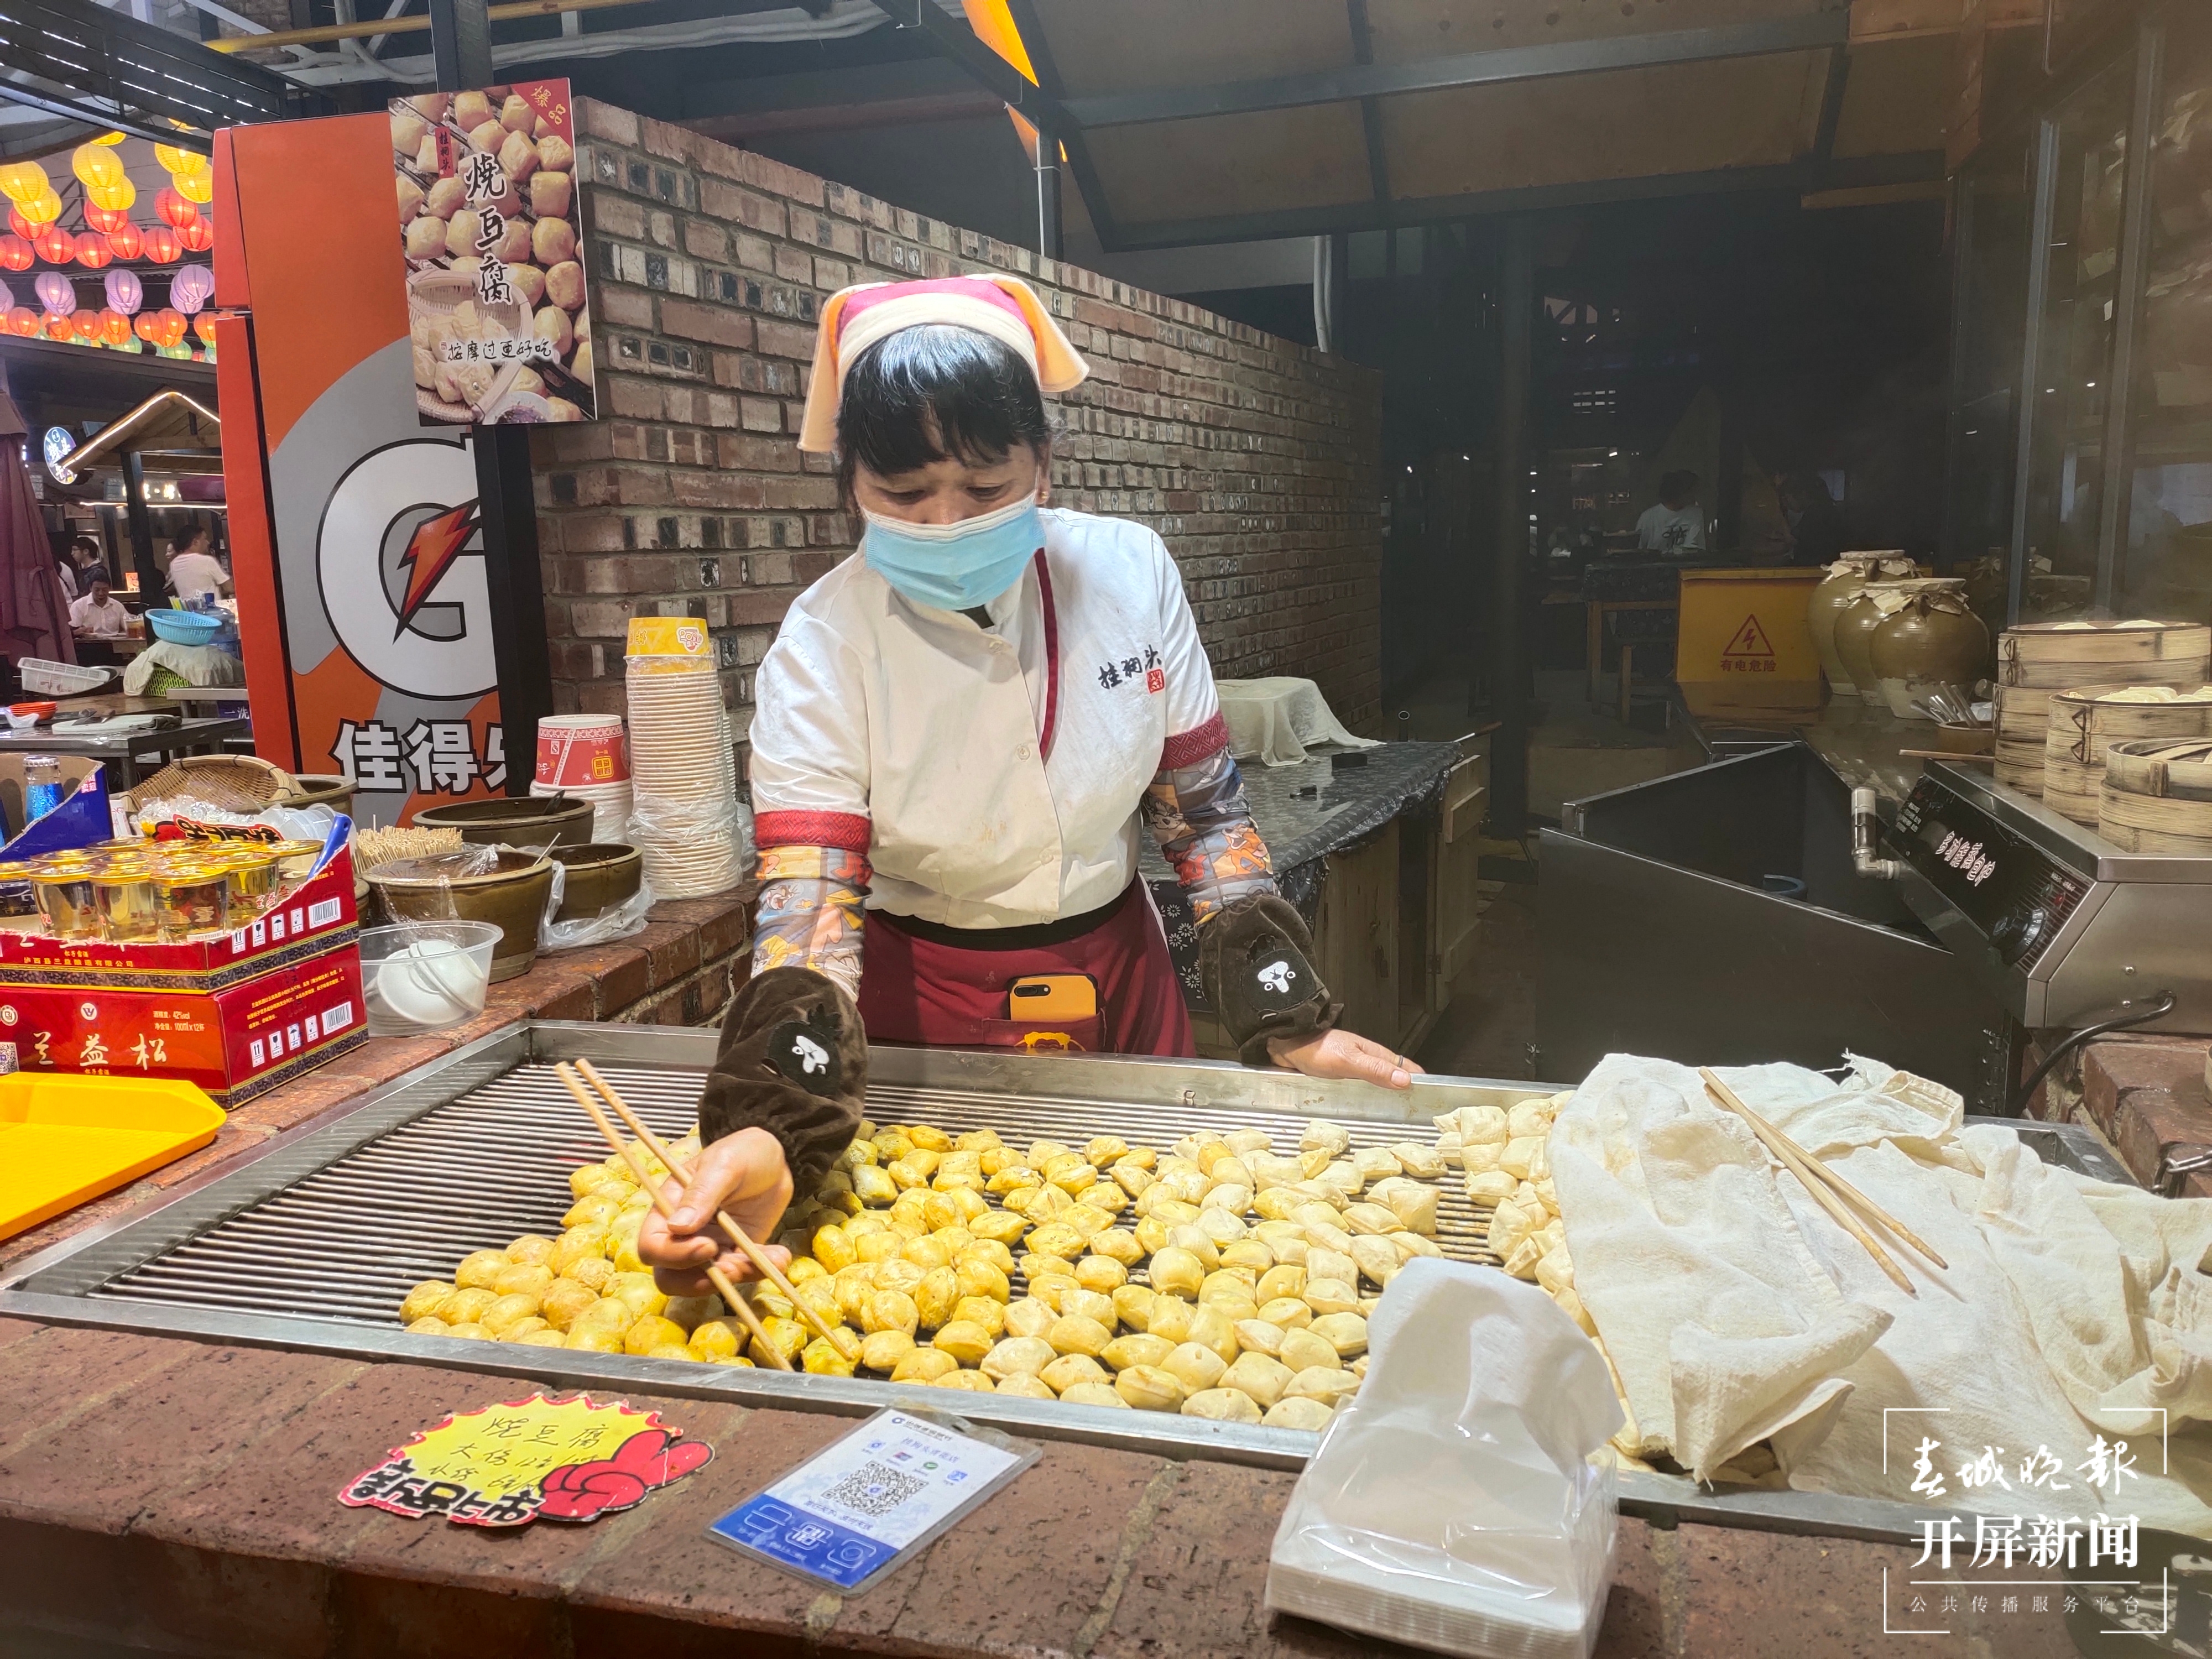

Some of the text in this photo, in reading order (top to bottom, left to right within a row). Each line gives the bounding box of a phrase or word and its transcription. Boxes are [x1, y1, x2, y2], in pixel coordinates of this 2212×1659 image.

[530, 86, 567, 126] 爆品
[447, 341, 552, 360] 按摩过更好吃
[316, 434, 499, 701] G
[1720, 659, 1777, 672] 有电危险
